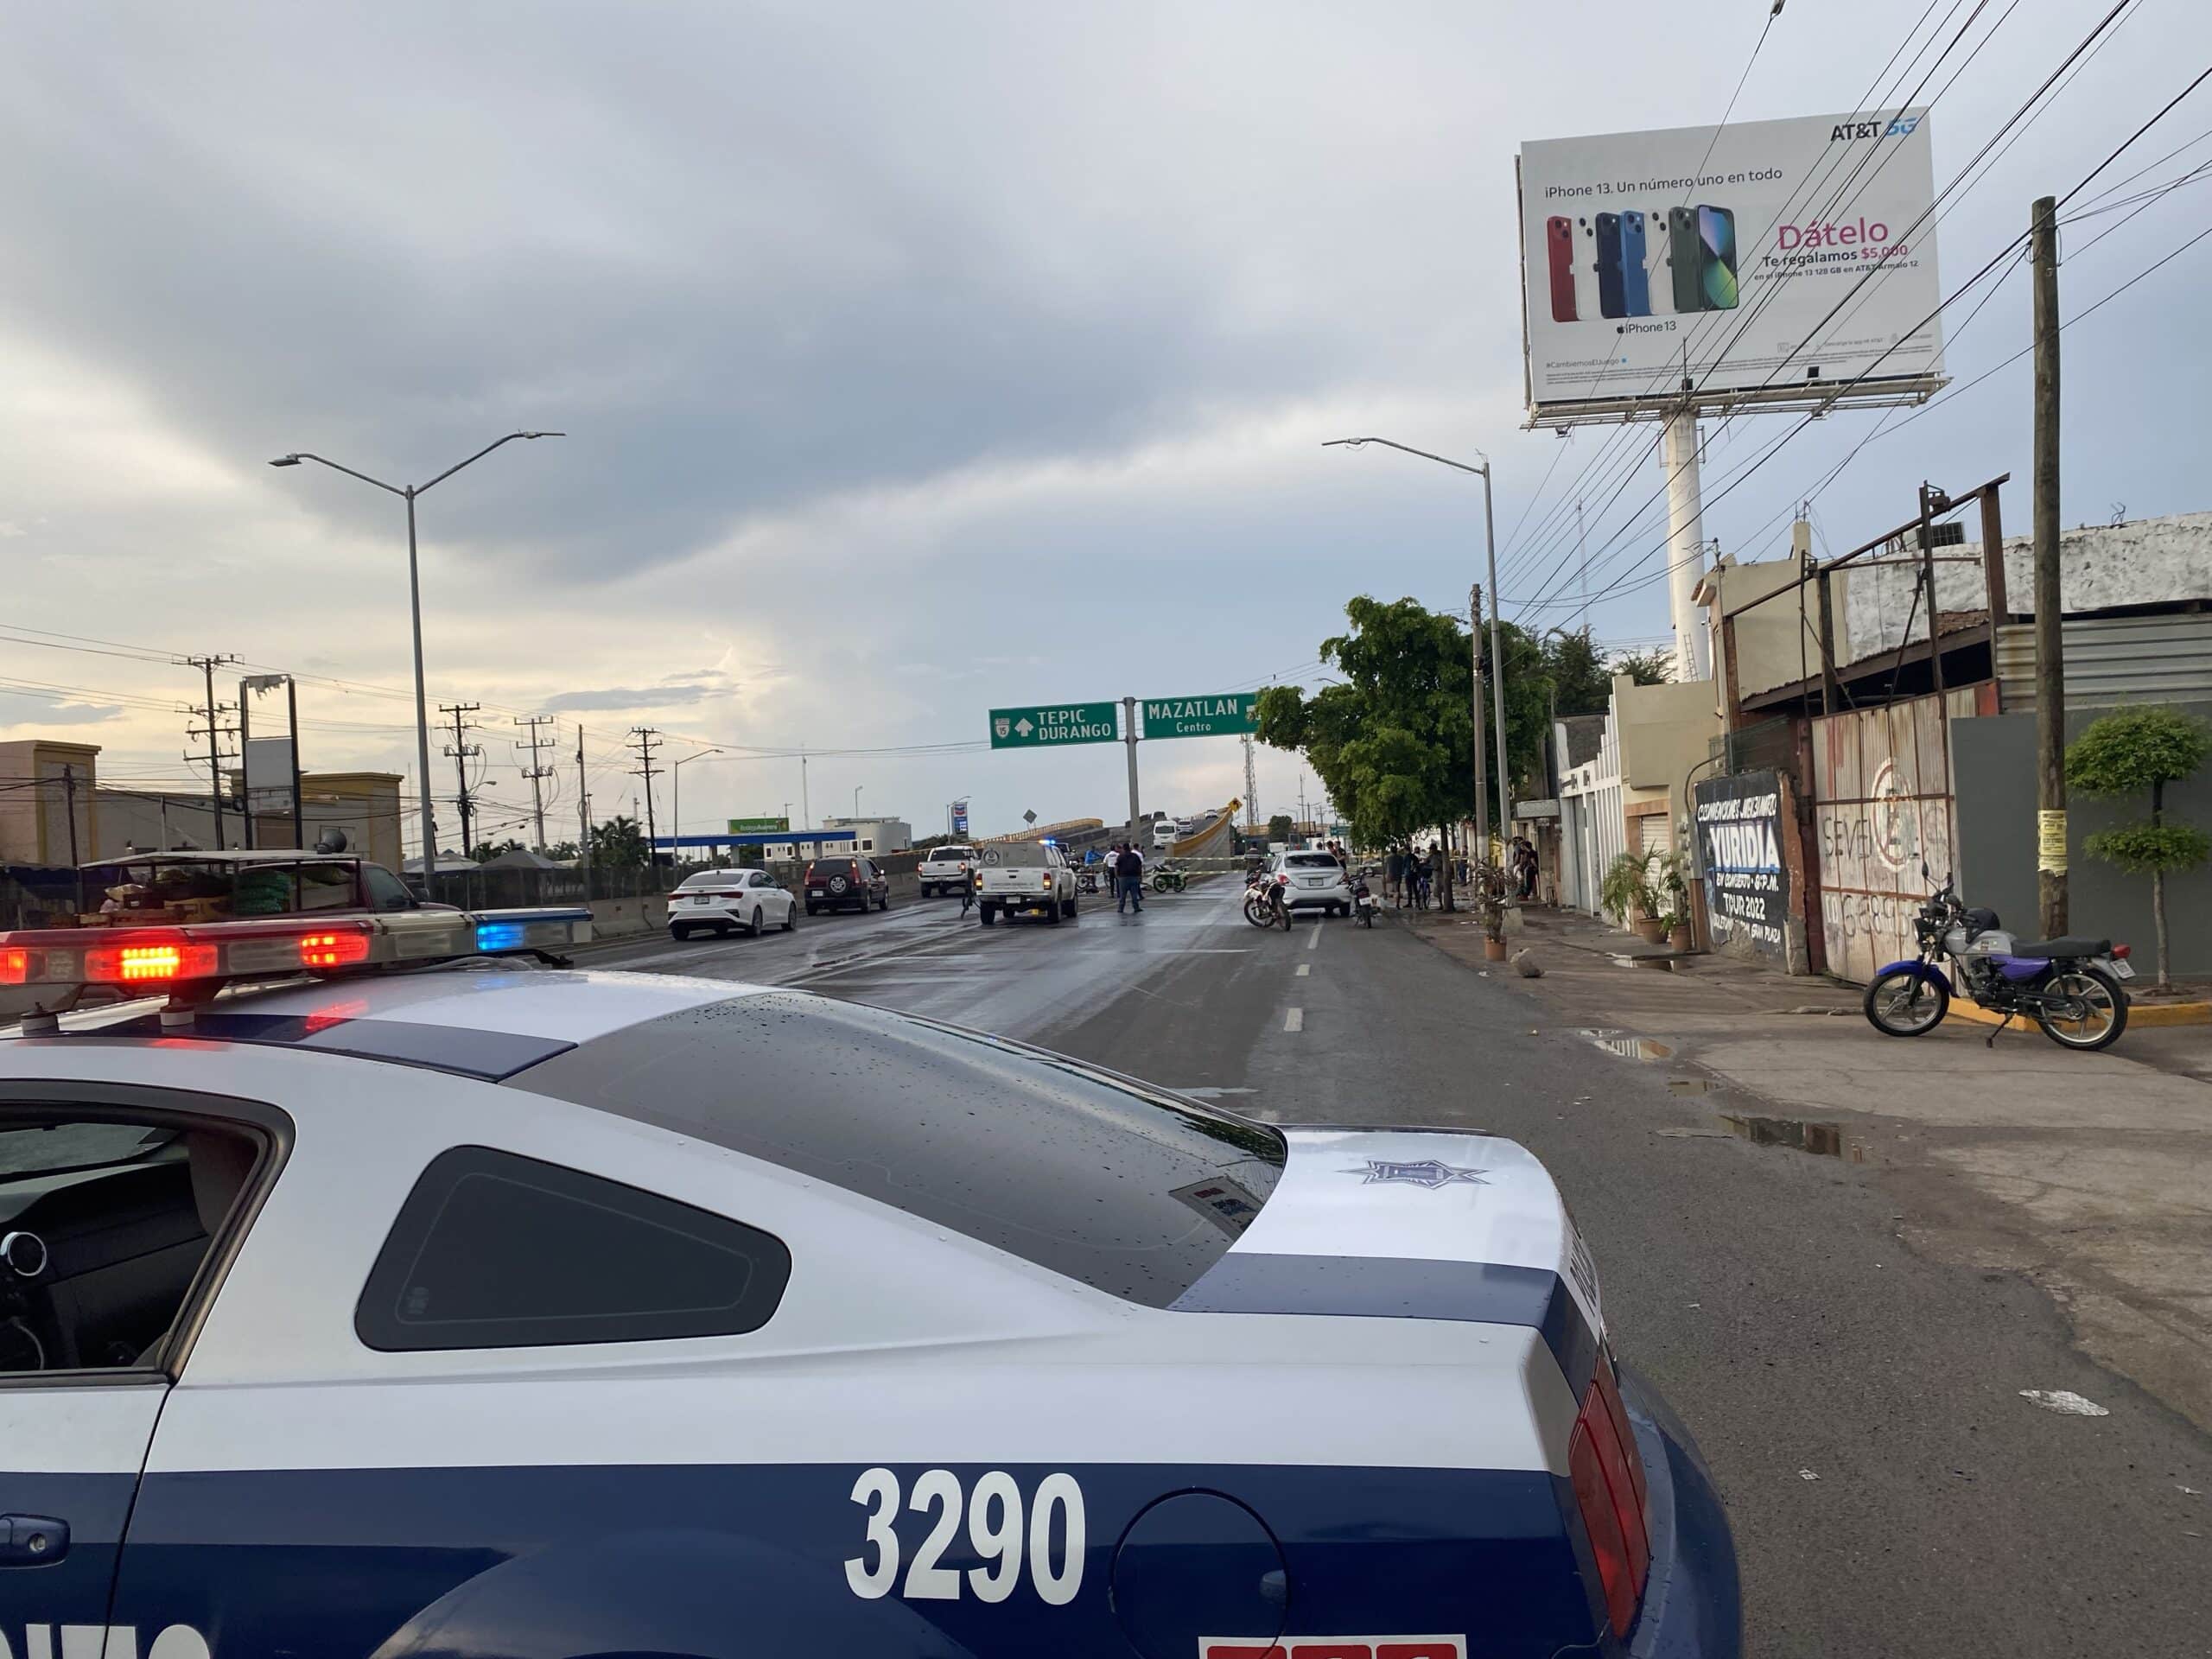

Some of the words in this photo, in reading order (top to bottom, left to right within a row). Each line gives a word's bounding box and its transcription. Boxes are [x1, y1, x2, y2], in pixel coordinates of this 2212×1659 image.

[1831, 121, 1882, 141] AT&T
[1545, 185, 1592, 199] iPhone
[1597, 183, 1613, 195] 13.
[1617, 181, 1636, 193] Un
[1639, 176, 1694, 192] número
[1697, 175, 1724, 187] uno
[1728, 173, 1745, 183] en
[1749, 168, 1783, 182] todo
[1778, 216, 1889, 250] Dátelo
[1764, 256, 1779, 267] Te
[1783, 250, 1858, 267] regalamos
[1861, 245, 1908, 261] $5,000
[1625, 323, 1663, 334] iPhone
[1665, 321, 1676, 331] 13
[1037, 709, 1085, 725] TEPIC
[1148, 698, 1237, 720] MAZATLAN
[999, 727, 1007, 735] 15
[1039, 723, 1111, 740] DURANGO
[1176, 721, 1211, 733] Centro
[1709, 823, 1781, 868] YURIDIA
[1723, 892, 1745, 917] TOUR
[1745, 896, 1766, 920] 2022
[843, 1467, 1086, 1605] 3290
